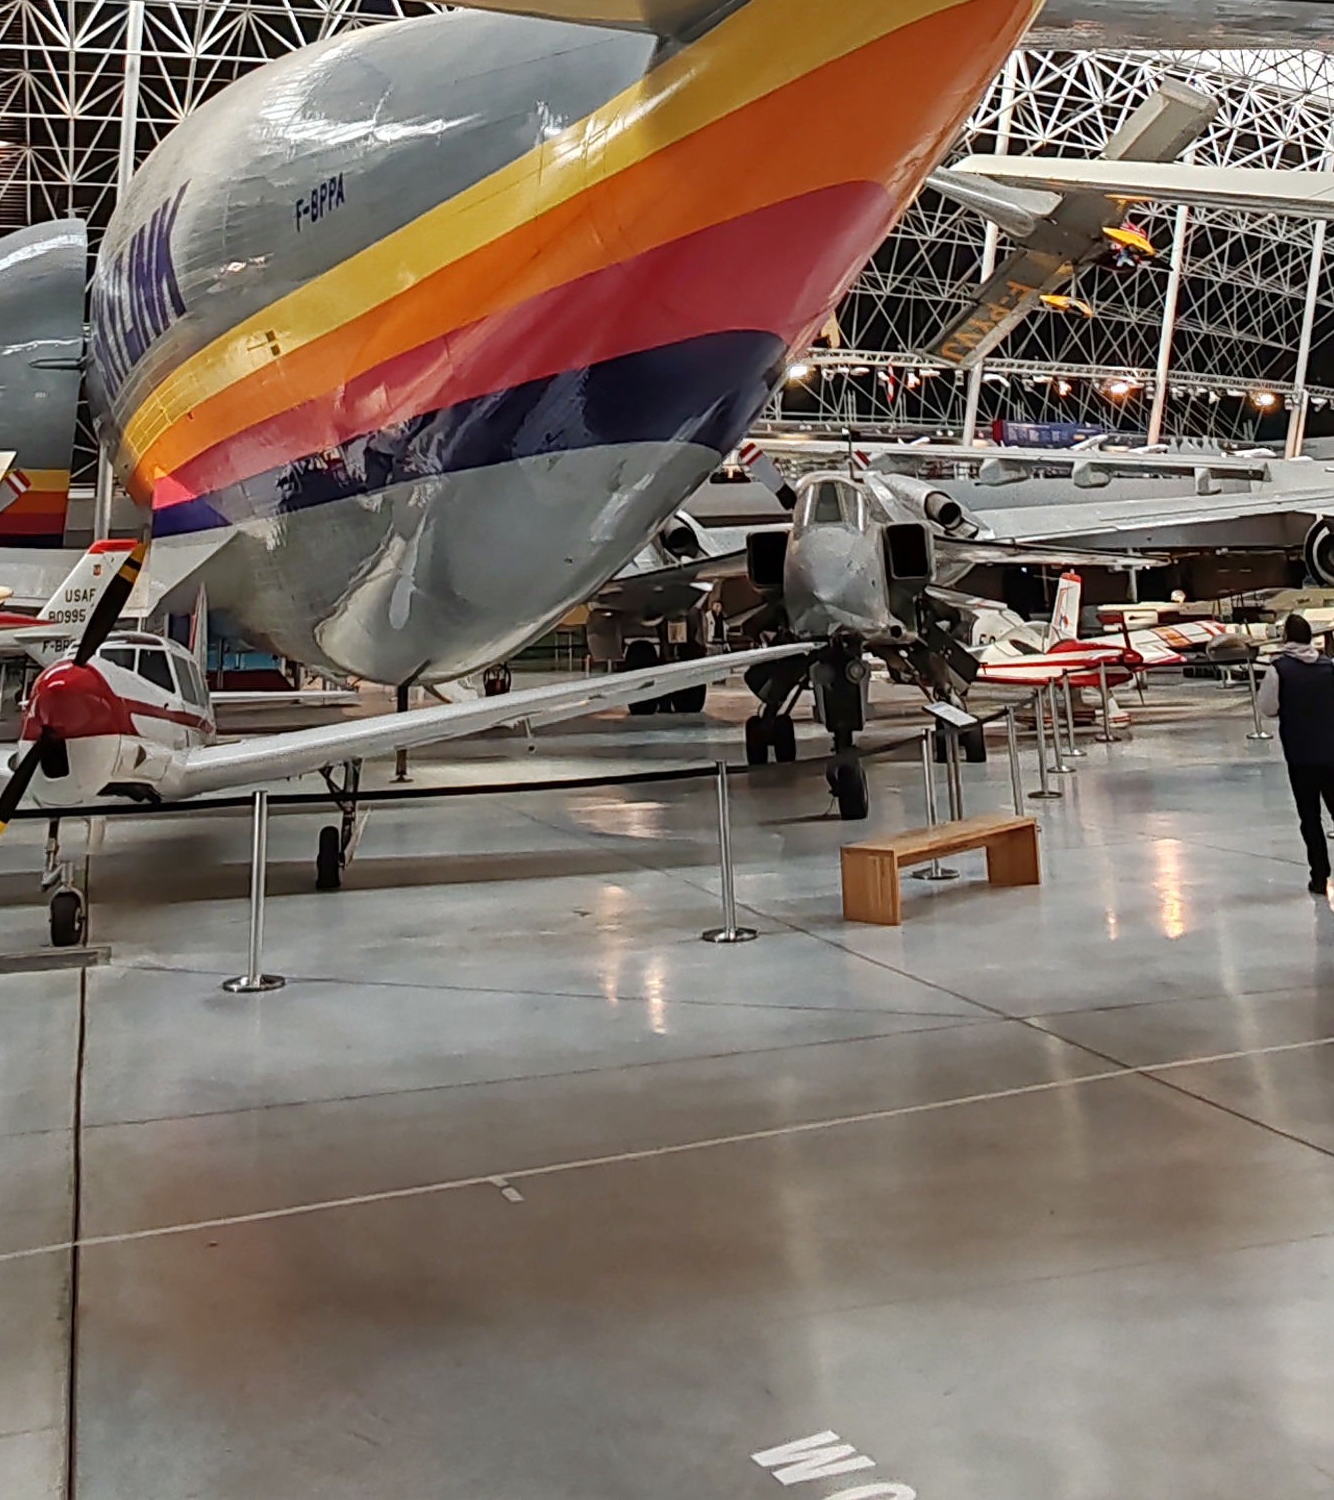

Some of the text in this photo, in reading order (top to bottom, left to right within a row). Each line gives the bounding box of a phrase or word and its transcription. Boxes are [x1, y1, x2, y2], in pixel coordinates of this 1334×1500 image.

[295, 171, 345, 233] F-BPPA
[65, 587, 97, 603] USAF
[48, 608, 87, 624] 80995
